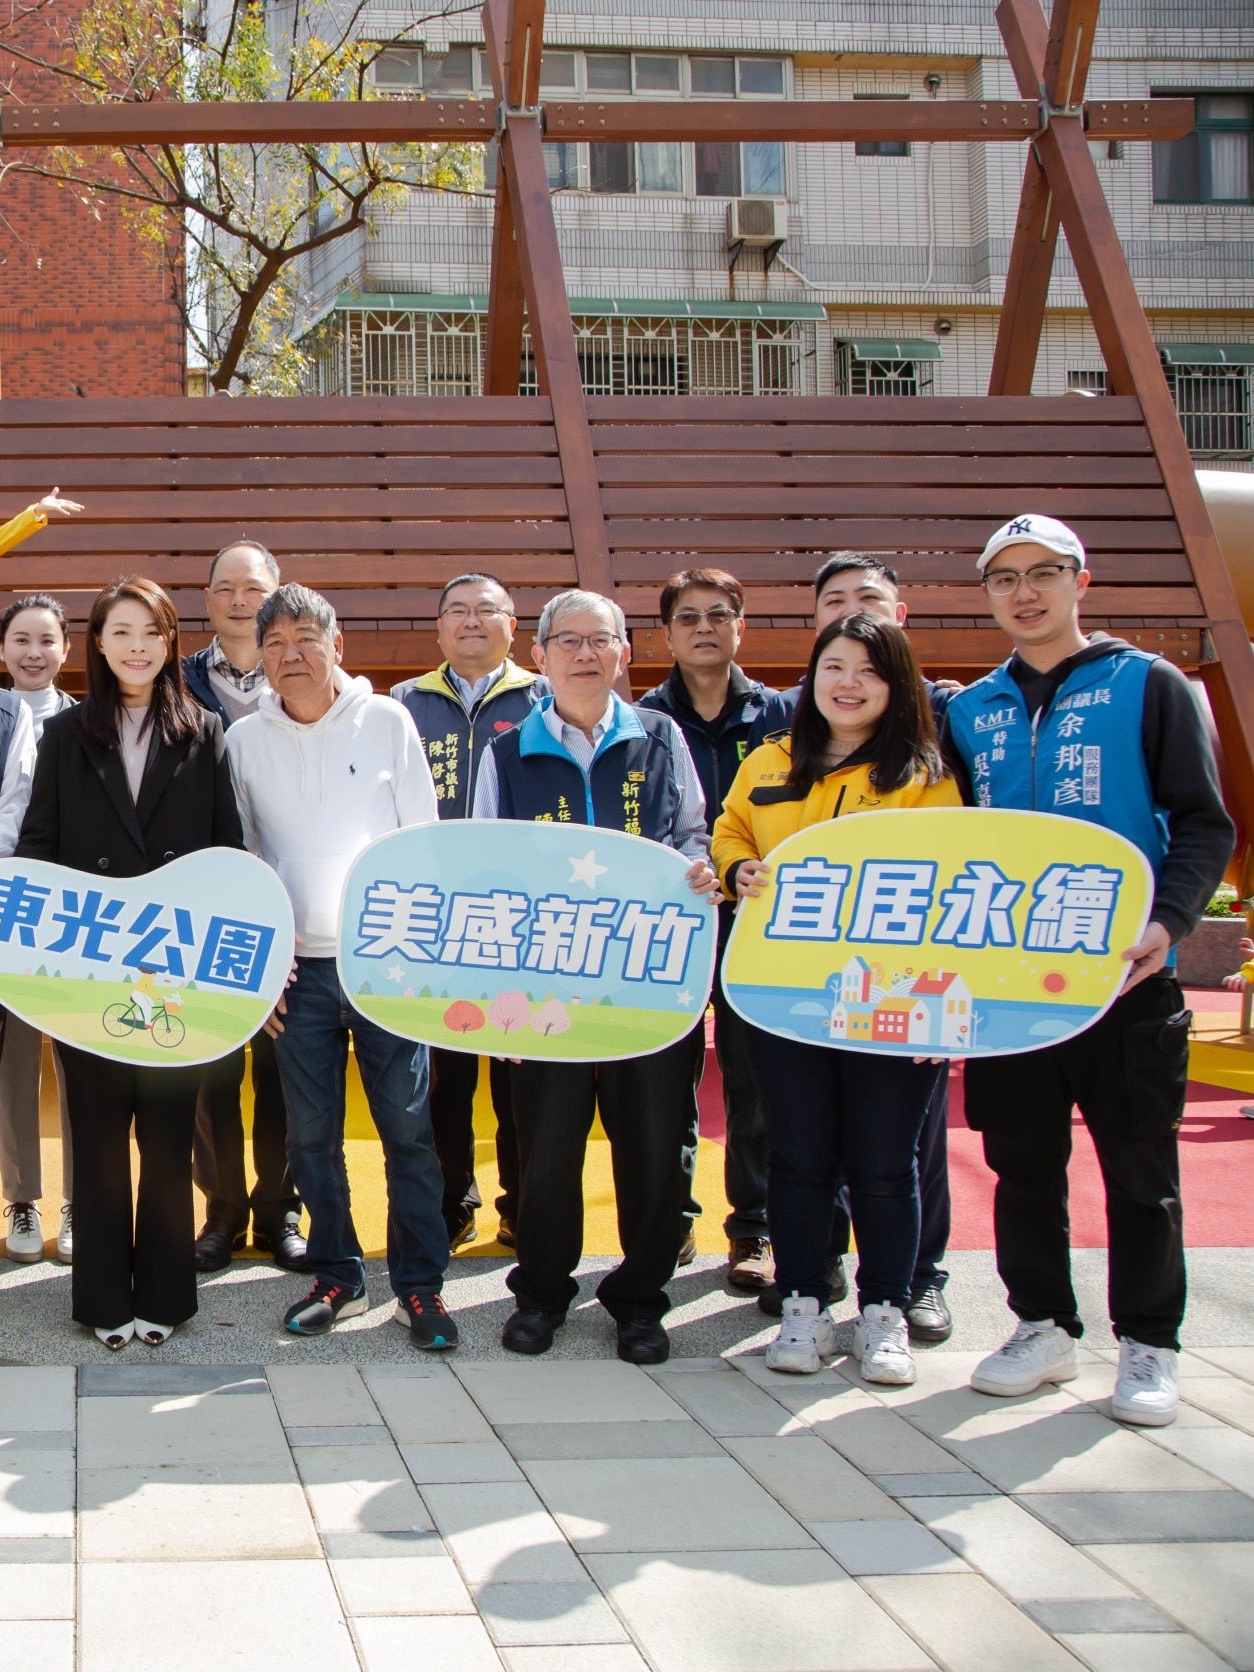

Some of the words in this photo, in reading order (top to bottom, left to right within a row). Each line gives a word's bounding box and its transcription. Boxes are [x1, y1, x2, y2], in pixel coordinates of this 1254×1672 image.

[974, 707, 1018, 730] KMT
[445, 733, 458, 799] 新竹市議員
[991, 731, 1007, 761] 特助
[558, 796, 571, 821] 主任
[764, 857, 1123, 955] 宜居永續
[353, 880, 705, 985] 美感新竹
